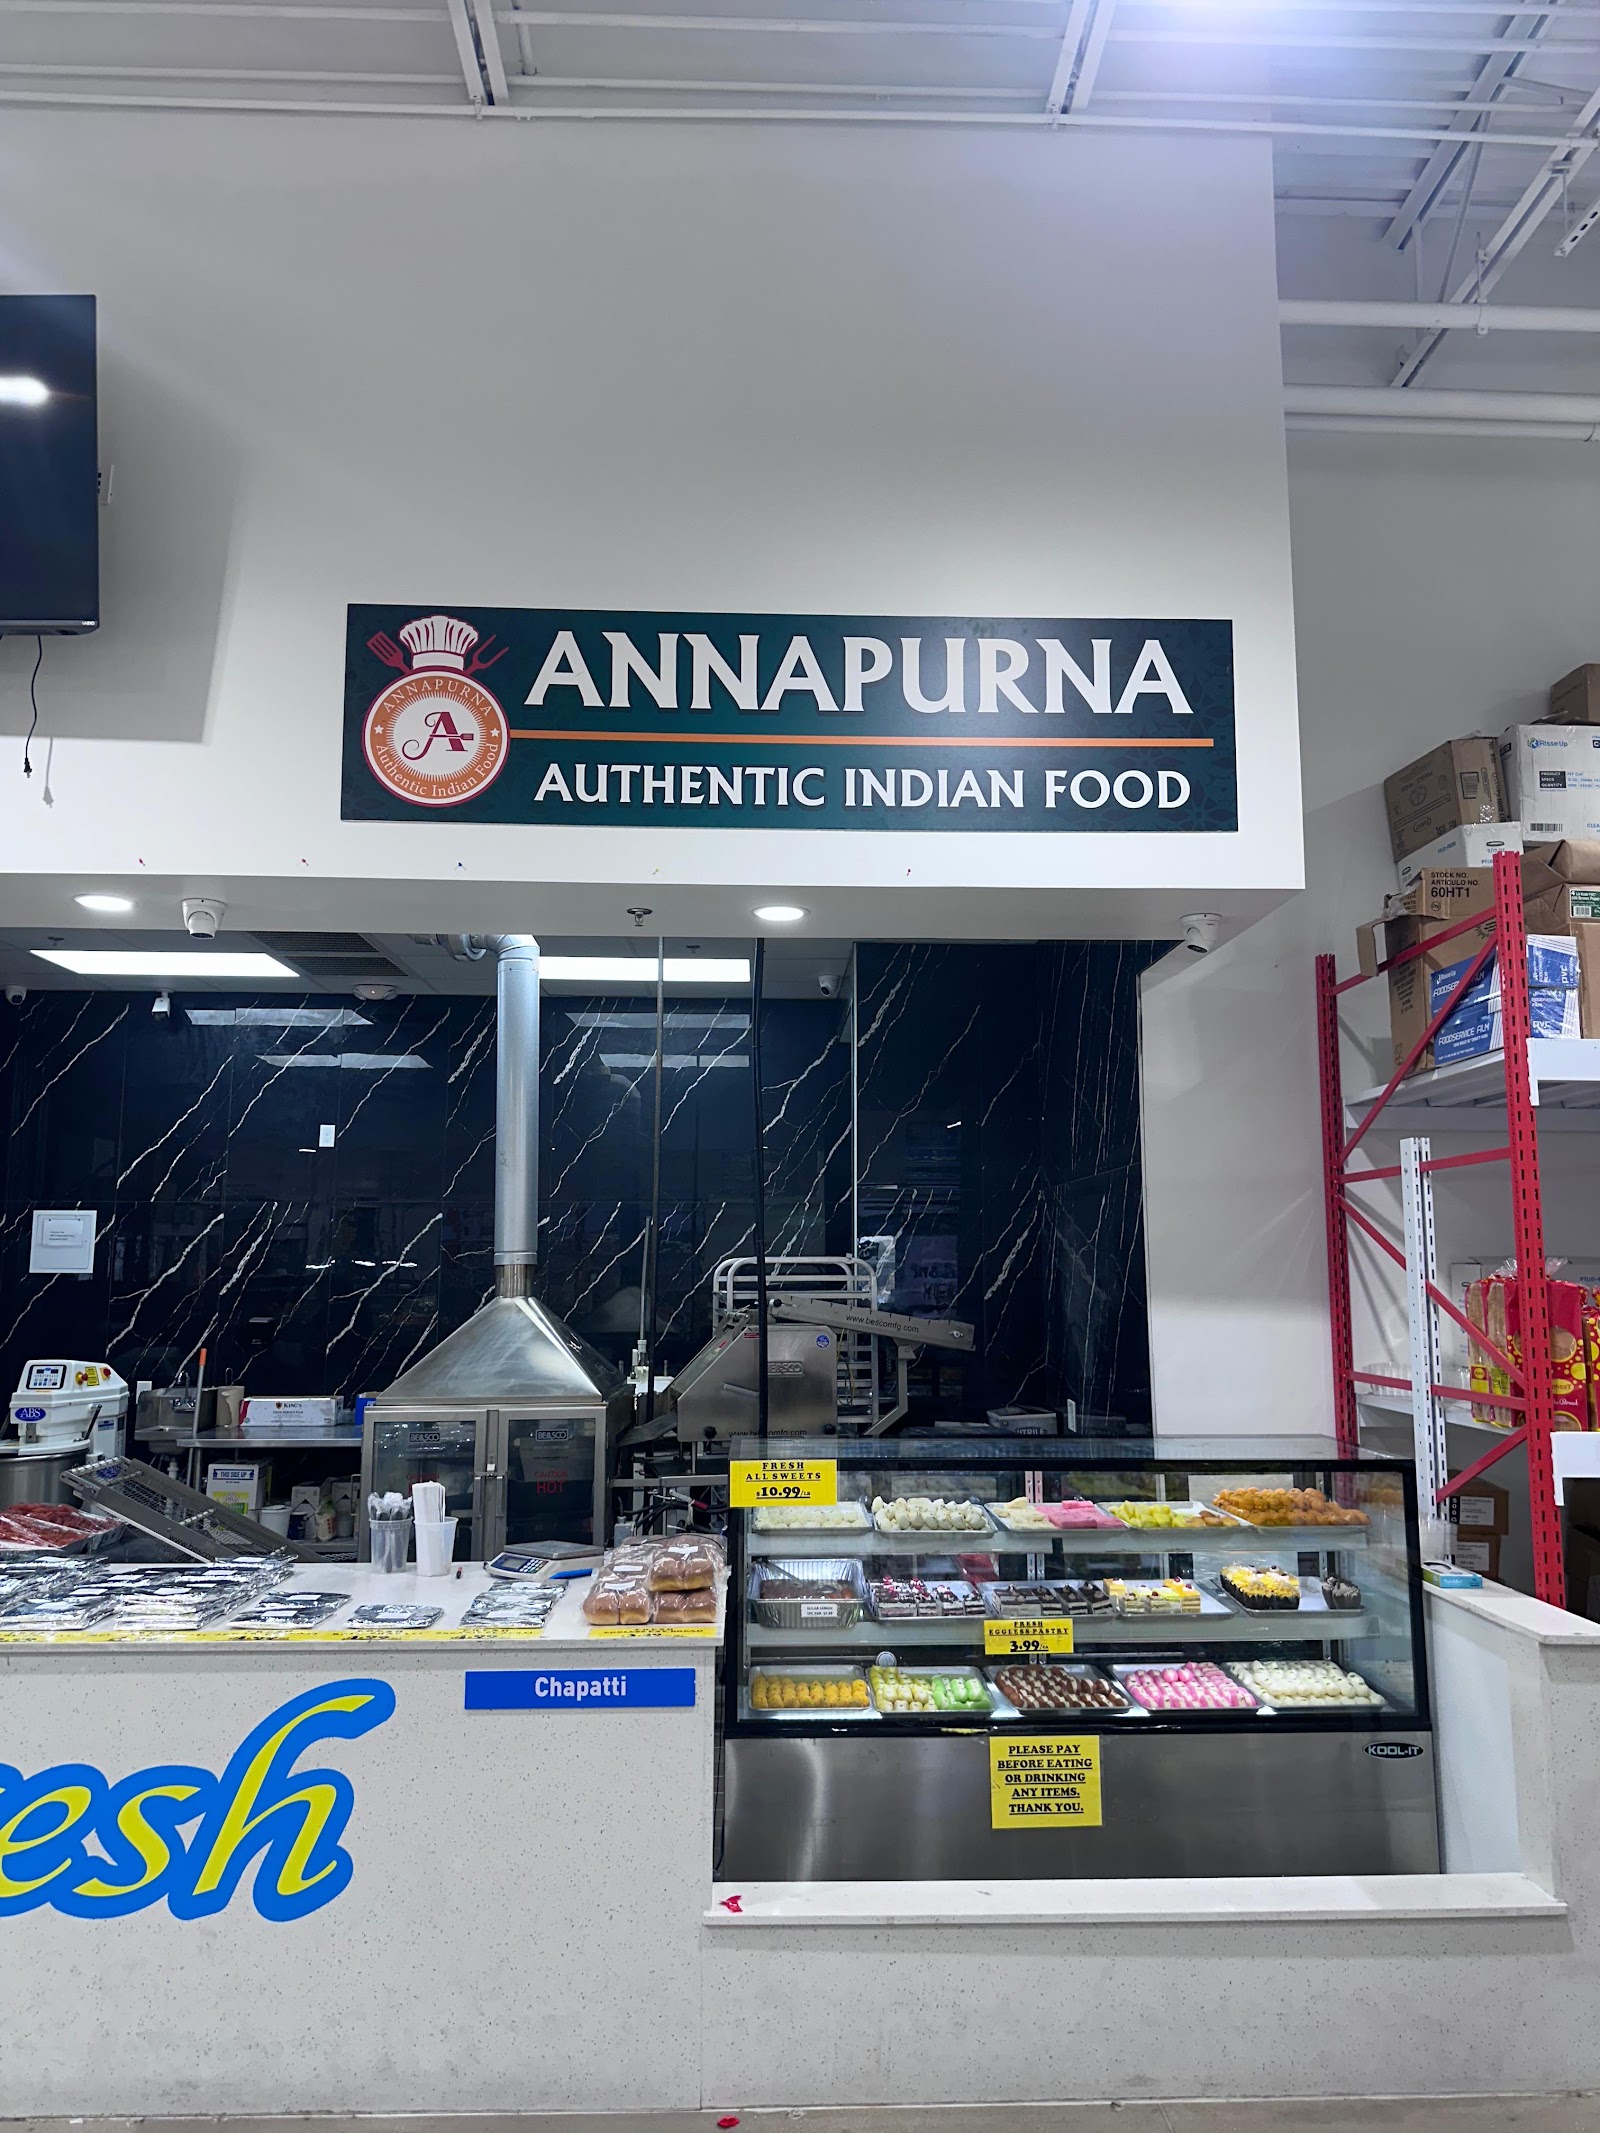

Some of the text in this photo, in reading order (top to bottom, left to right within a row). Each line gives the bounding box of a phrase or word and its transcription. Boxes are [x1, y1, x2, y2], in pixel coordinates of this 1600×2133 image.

[524, 630, 1194, 714] ANNAPURNA
[382, 679, 492, 716] ANNAPURNA
[474, 743, 499, 777] Food
[376, 744, 427, 795] Authentic
[432, 777, 478, 797] Indian
[534, 763, 1191, 809] AUTHENTIC INDIAN FOOD
[1430, 871, 1456, 879] STOCK
[1430, 886, 1470, 898] 60HT1
[846, 1313, 920, 1333] www.bescomfg.com
[20, 1407, 41, 1418] ABS
[537, 1431, 567, 1440] BE&SCO
[762, 1462, 804, 1470] FRESH
[771, 1472, 821, 1480] SWEETS
[536, 1480, 565, 1494] HOT
[534, 1676, 627, 1701] Chapatti
[1008, 1744, 1081, 1754] PLEASE PAY
[998, 1758, 1093, 1769] BEFORE EATING
[1005, 1773, 1086, 1783] OR DRINKING
[0, 1691, 382, 1902] esh
[1012, 1787, 1080, 1797] ANY ITEMS.
[1009, 1802, 1084, 1813] THANK YOU.
